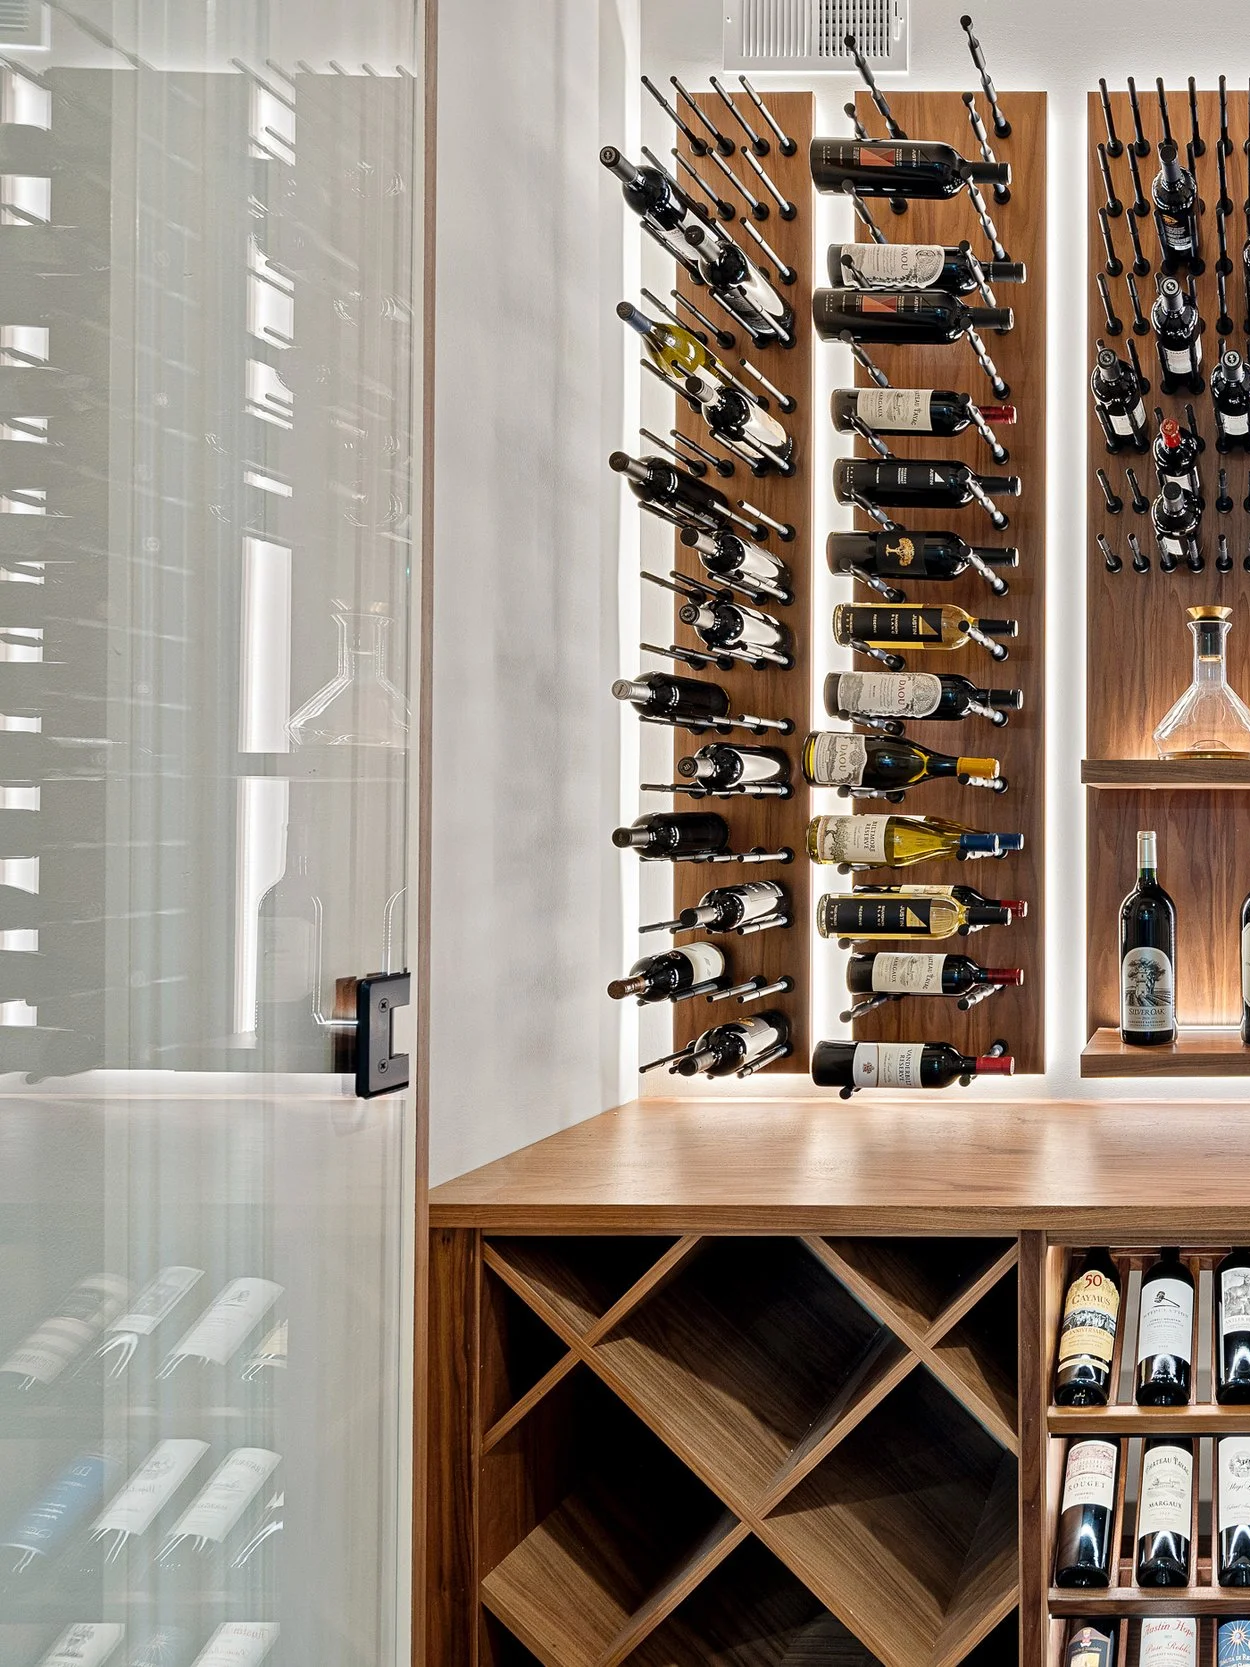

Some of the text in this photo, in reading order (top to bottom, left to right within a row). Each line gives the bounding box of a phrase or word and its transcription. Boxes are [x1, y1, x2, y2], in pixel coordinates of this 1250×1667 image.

[898, 679, 906, 707] DAOU
[840, 744, 848, 772] DAOU
[863, 823, 871, 850] RESERVE
[869, 821, 877, 852] BILTMORE
[1128, 1007, 1165, 1015] SILVER OAK
[898, 1055, 906, 1081] RESERVE
[904, 1048, 912, 1086] VANDERBILT
[1084, 1274, 1102, 1289] 50
[1072, 1293, 1111, 1306] CAYMUS
[1068, 1480, 1106, 1492] ROUGET
[1149, 1500, 1182, 1509] MARGAUX
[1144, 1620, 1171, 1637] Justin
